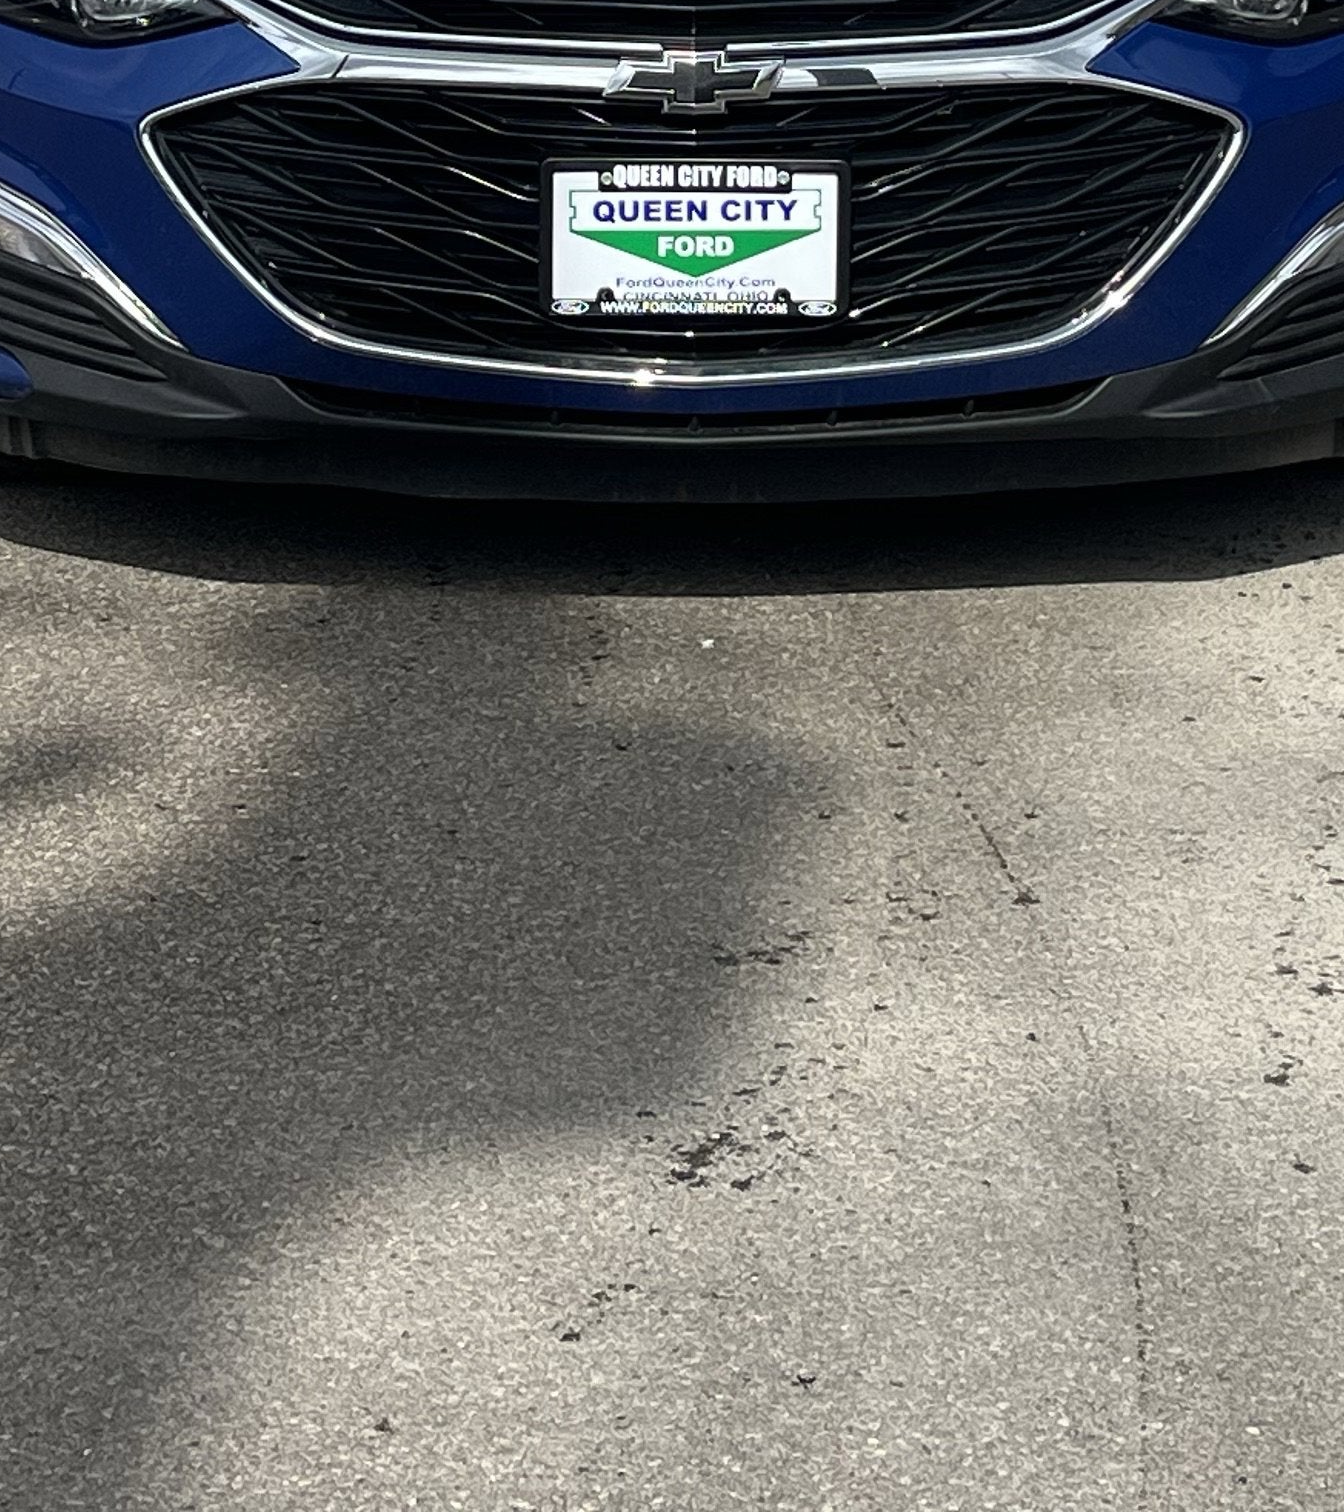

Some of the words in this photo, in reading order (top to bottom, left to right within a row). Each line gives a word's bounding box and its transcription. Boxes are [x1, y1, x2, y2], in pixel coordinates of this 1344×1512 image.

[612, 164, 675, 188] QUEEN
[678, 165, 724, 187] CITY
[726, 165, 778, 188] FORD
[592, 199, 708, 223] QUEEN
[720, 199, 798, 222] CITY
[657, 235, 735, 258] FORD
[600, 300, 788, 315] WWW.FORDQUEENCITY.COM
